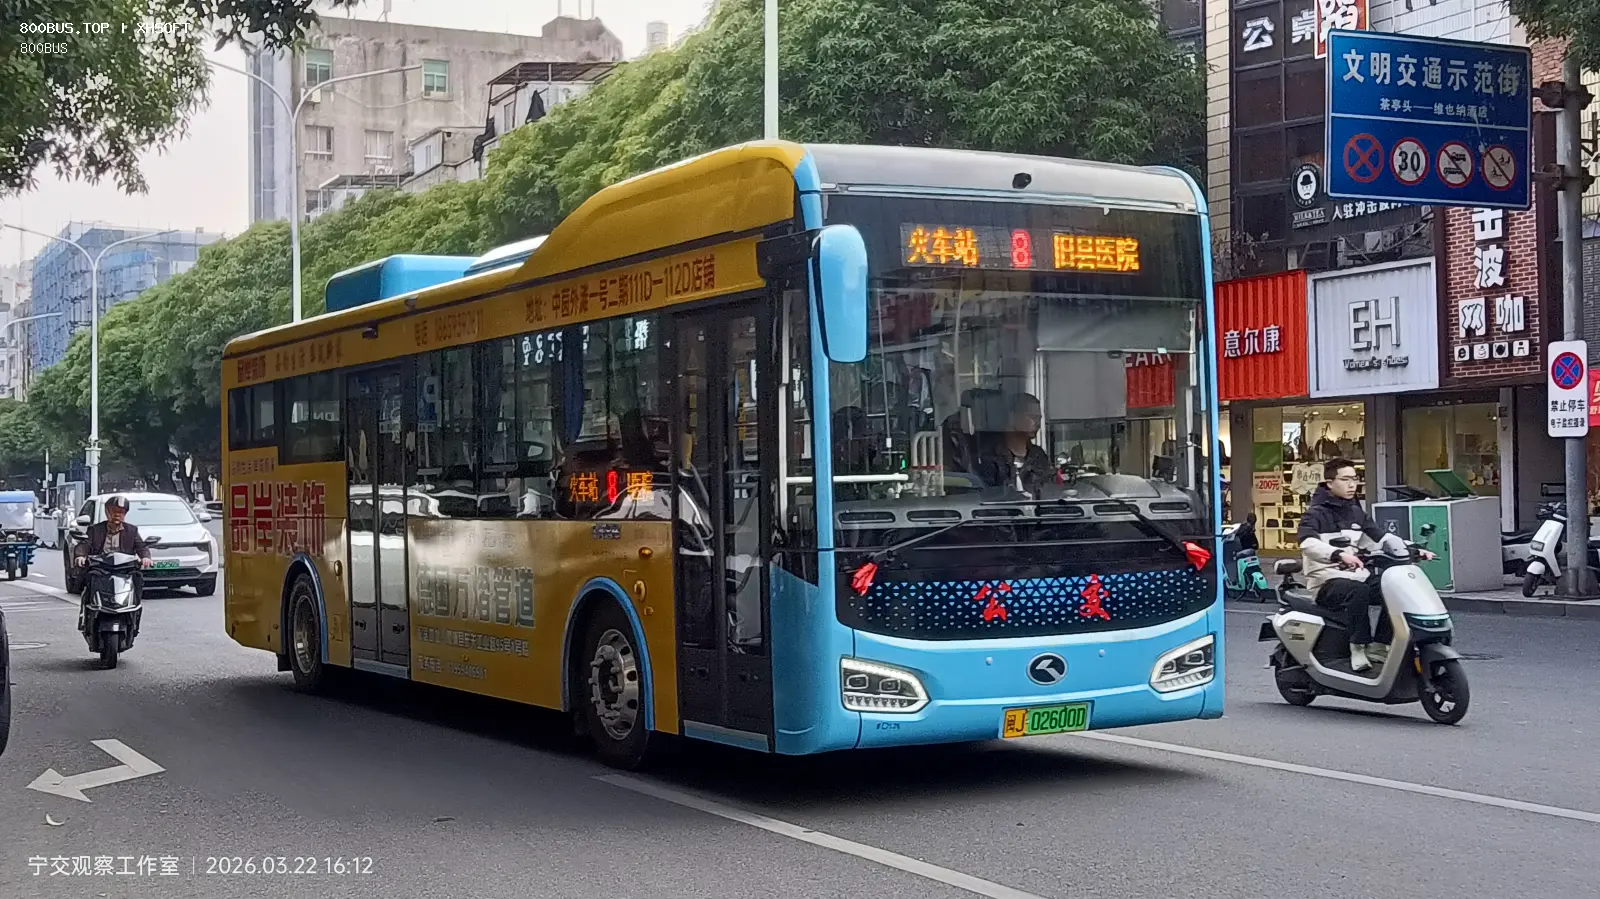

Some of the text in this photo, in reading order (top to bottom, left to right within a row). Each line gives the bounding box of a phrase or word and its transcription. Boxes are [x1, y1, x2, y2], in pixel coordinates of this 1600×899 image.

[1342, 48, 1522, 97] 文明交通示范街
[1399, 149, 1421, 172] 30
[907, 227, 979, 268] 火车站
[1011, 229, 1031, 268] 8
[1348, 297, 1400, 351] EH
[1458, 294, 1525, 338] 网咖
[1223, 324, 1283, 358] 意尔康
[1551, 399, 1586, 412] 禁止停车
[1030, 707, 1086, 731] 02600D
